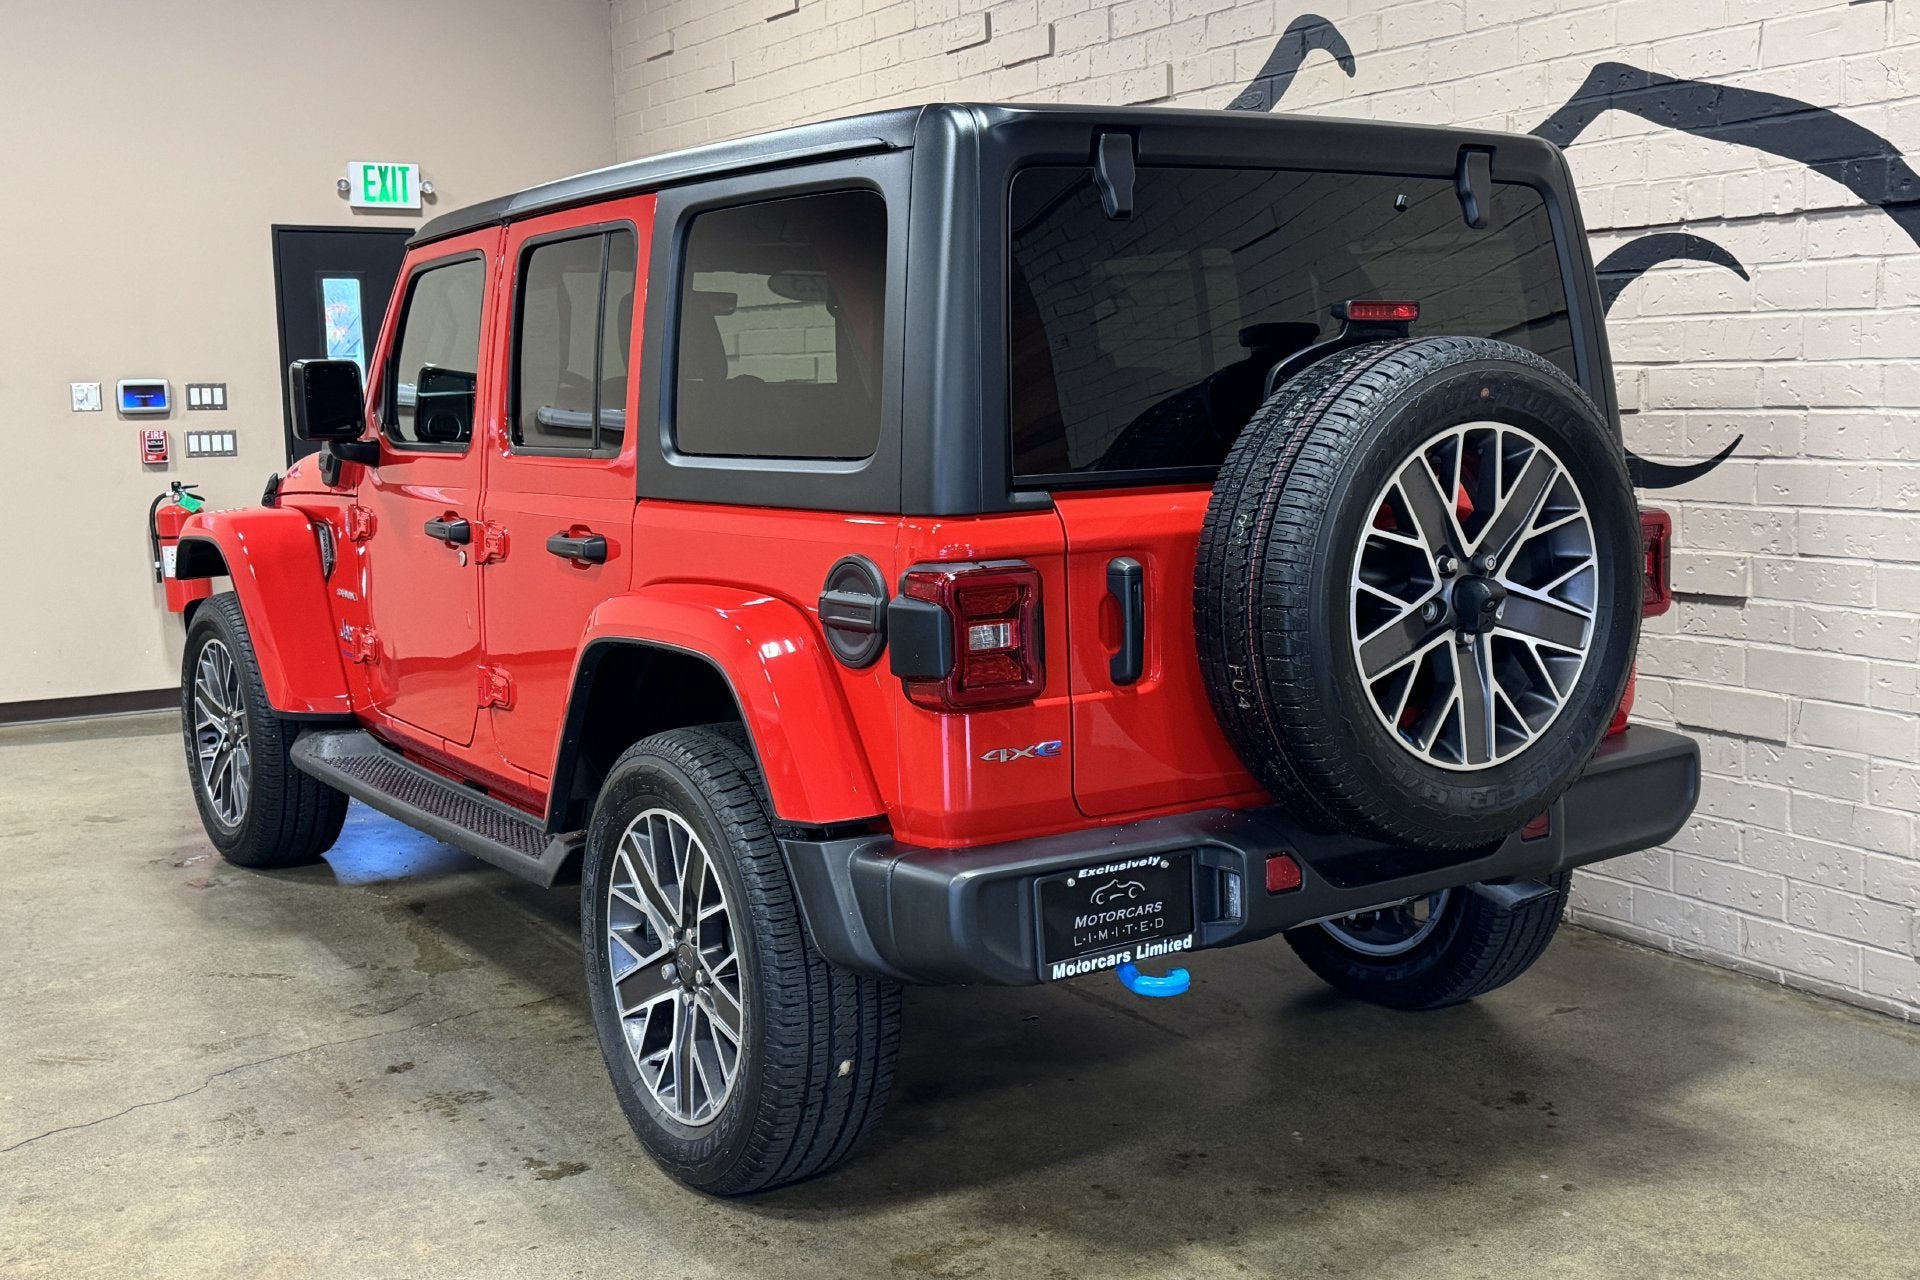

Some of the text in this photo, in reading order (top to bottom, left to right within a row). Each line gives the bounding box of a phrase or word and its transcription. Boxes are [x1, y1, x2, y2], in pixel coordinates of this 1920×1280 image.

[362, 165, 410, 203] EXIT
[144, 431, 164, 440] FIRE
[1078, 856, 1160, 878] Exclusively
[1074, 901, 1163, 929] MOTORCARS
[1052, 934, 1193, 979] Motorcars Limited
